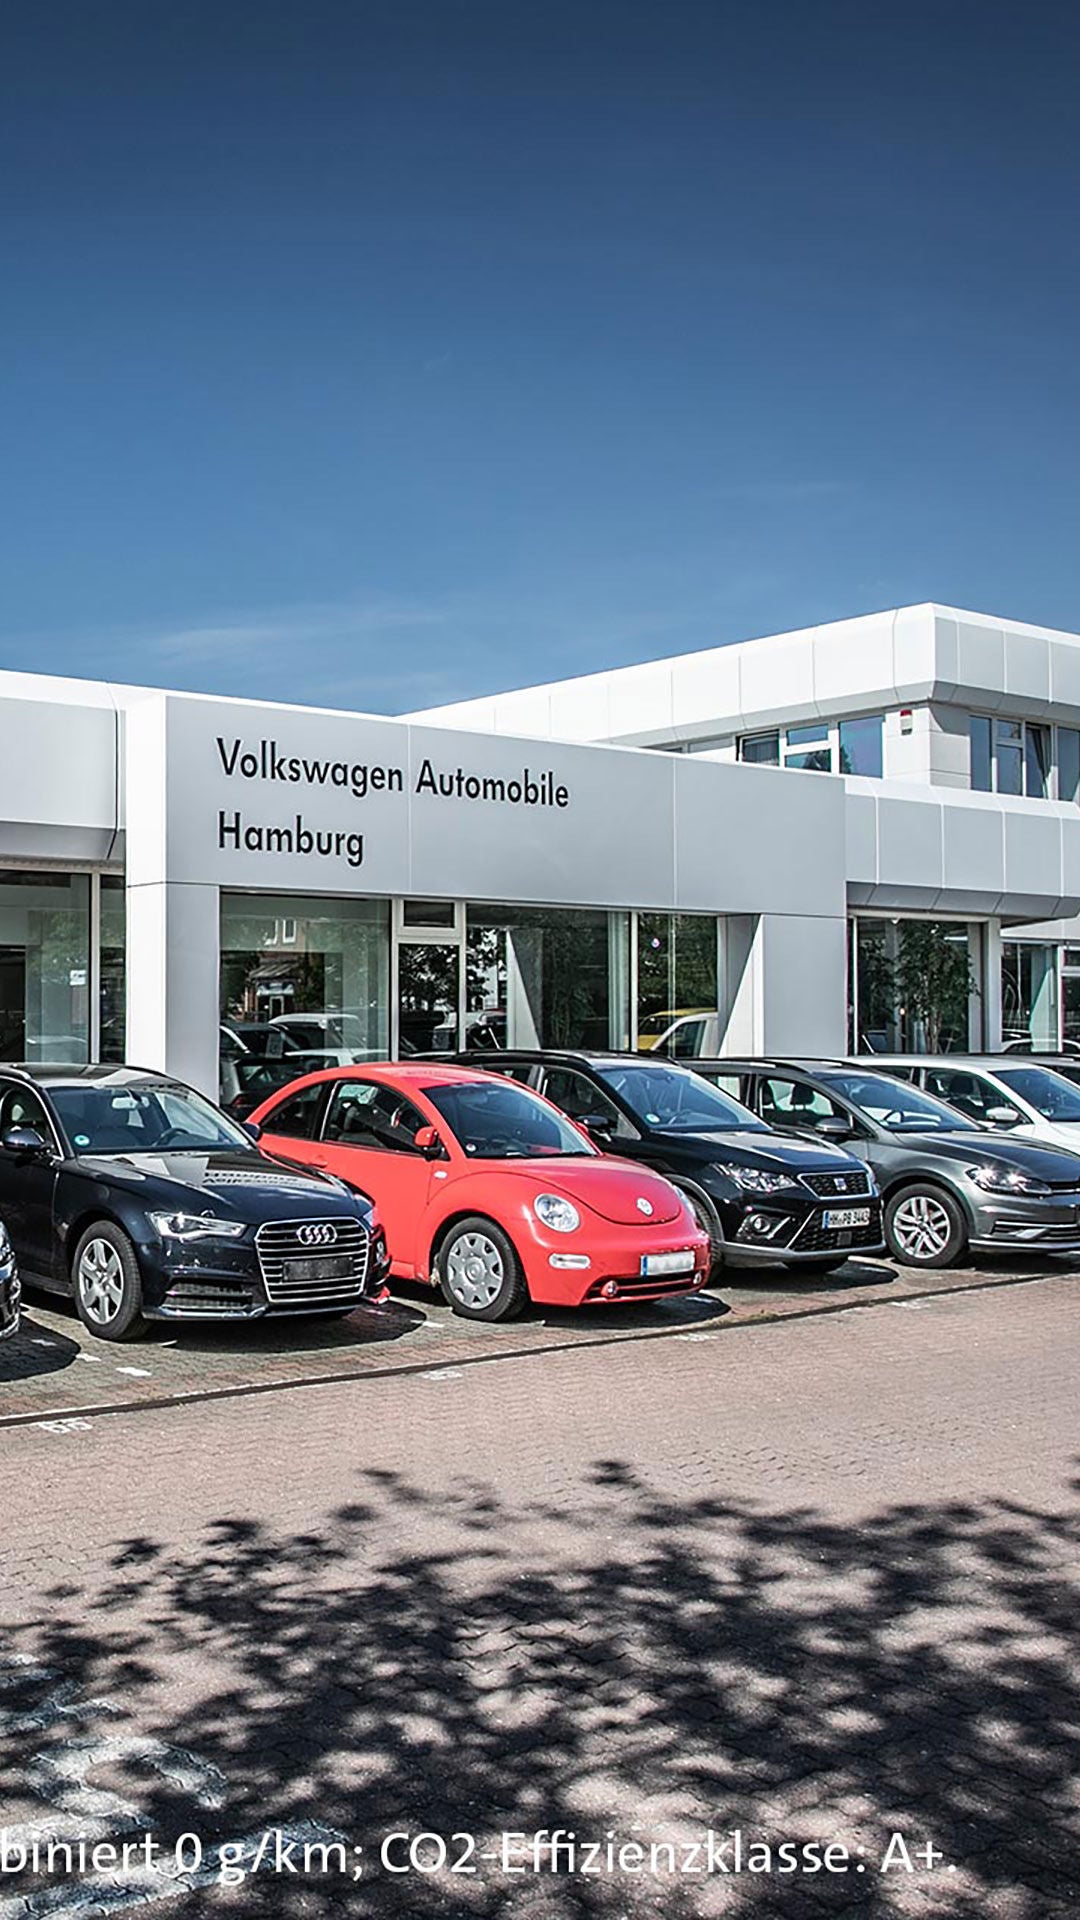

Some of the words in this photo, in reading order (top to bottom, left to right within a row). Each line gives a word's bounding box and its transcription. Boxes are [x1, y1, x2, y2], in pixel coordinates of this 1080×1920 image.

[216, 737, 403, 798] Volkswagen
[415, 759, 569, 807] Automobile
[217, 810, 364, 867] Hamburg
